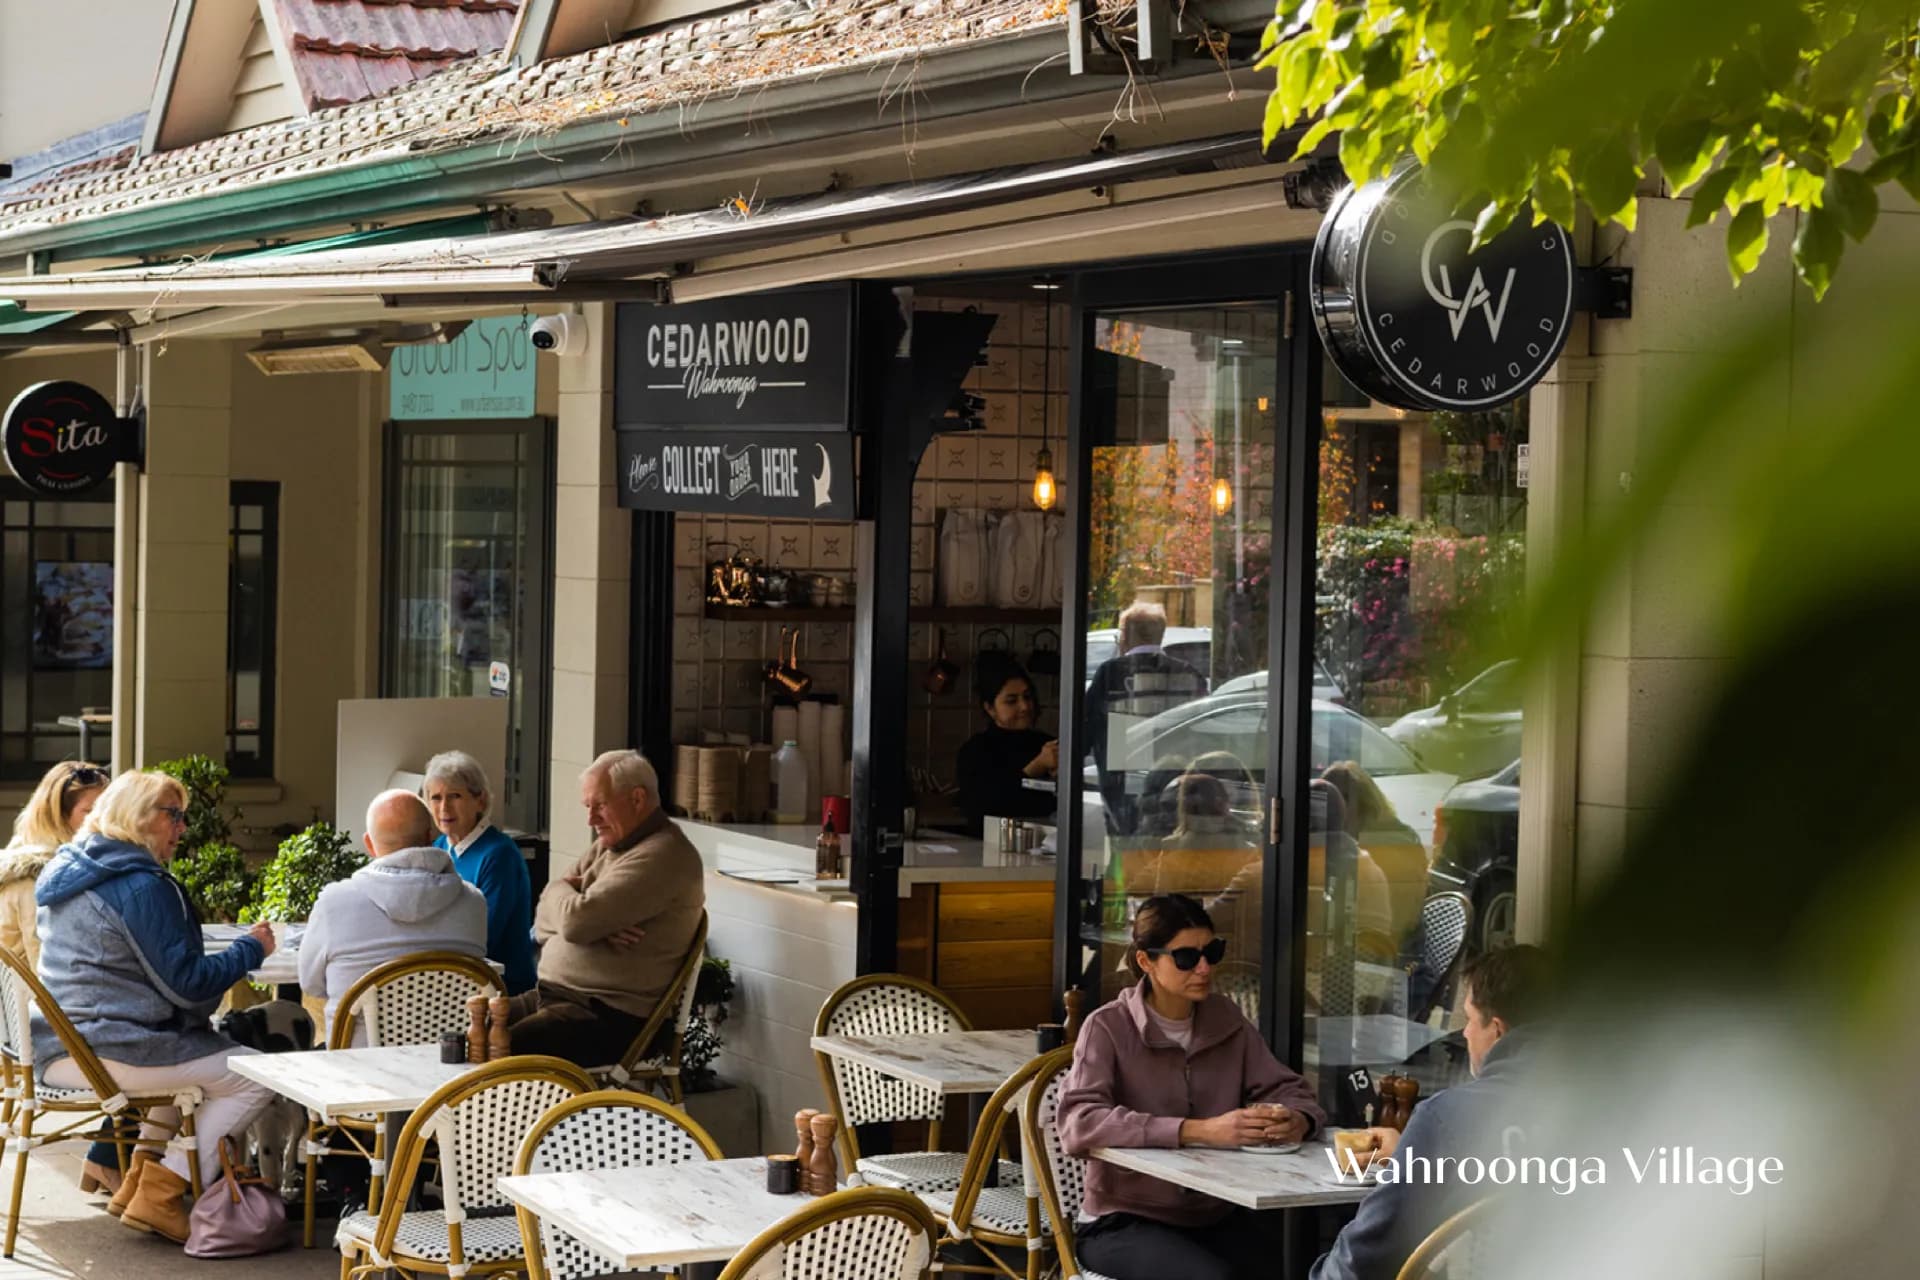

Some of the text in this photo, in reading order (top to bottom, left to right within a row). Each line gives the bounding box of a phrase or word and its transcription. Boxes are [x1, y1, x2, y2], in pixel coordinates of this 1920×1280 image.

[647, 317, 810, 368] CEDARWOOD
[1379, 312, 1554, 394] CEDARWOOD
[683, 363, 758, 410] Wahroonga
[20, 417, 108, 457] Sita
[662, 445, 721, 494] COLLECT
[761, 447, 800, 498] HERE
[1348, 1069, 1370, 1092] 13
